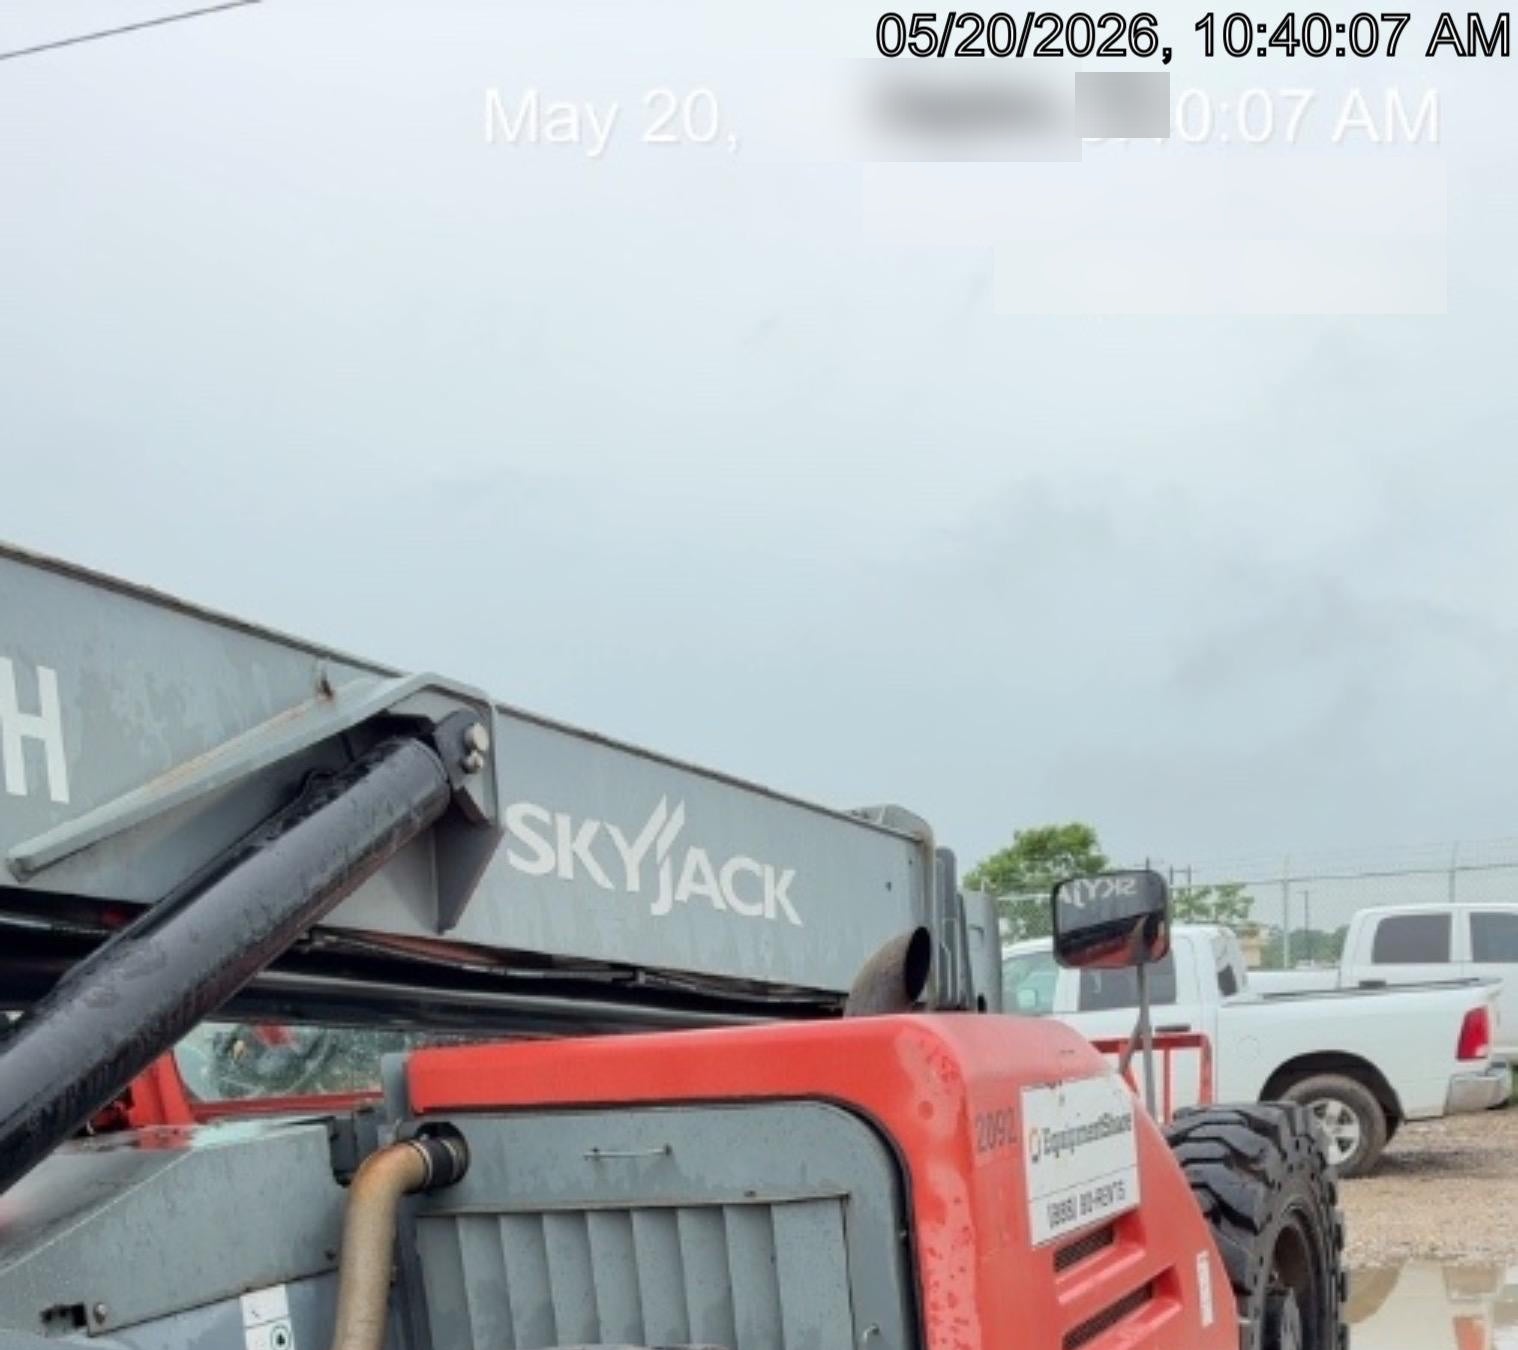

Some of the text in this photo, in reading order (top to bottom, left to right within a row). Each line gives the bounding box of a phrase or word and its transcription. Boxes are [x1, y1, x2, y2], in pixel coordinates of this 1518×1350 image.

[0, 656, 70, 804] H
[505, 794, 802, 925] SKYJACK
[1042, 1112, 1132, 1158] EquipmentShare
